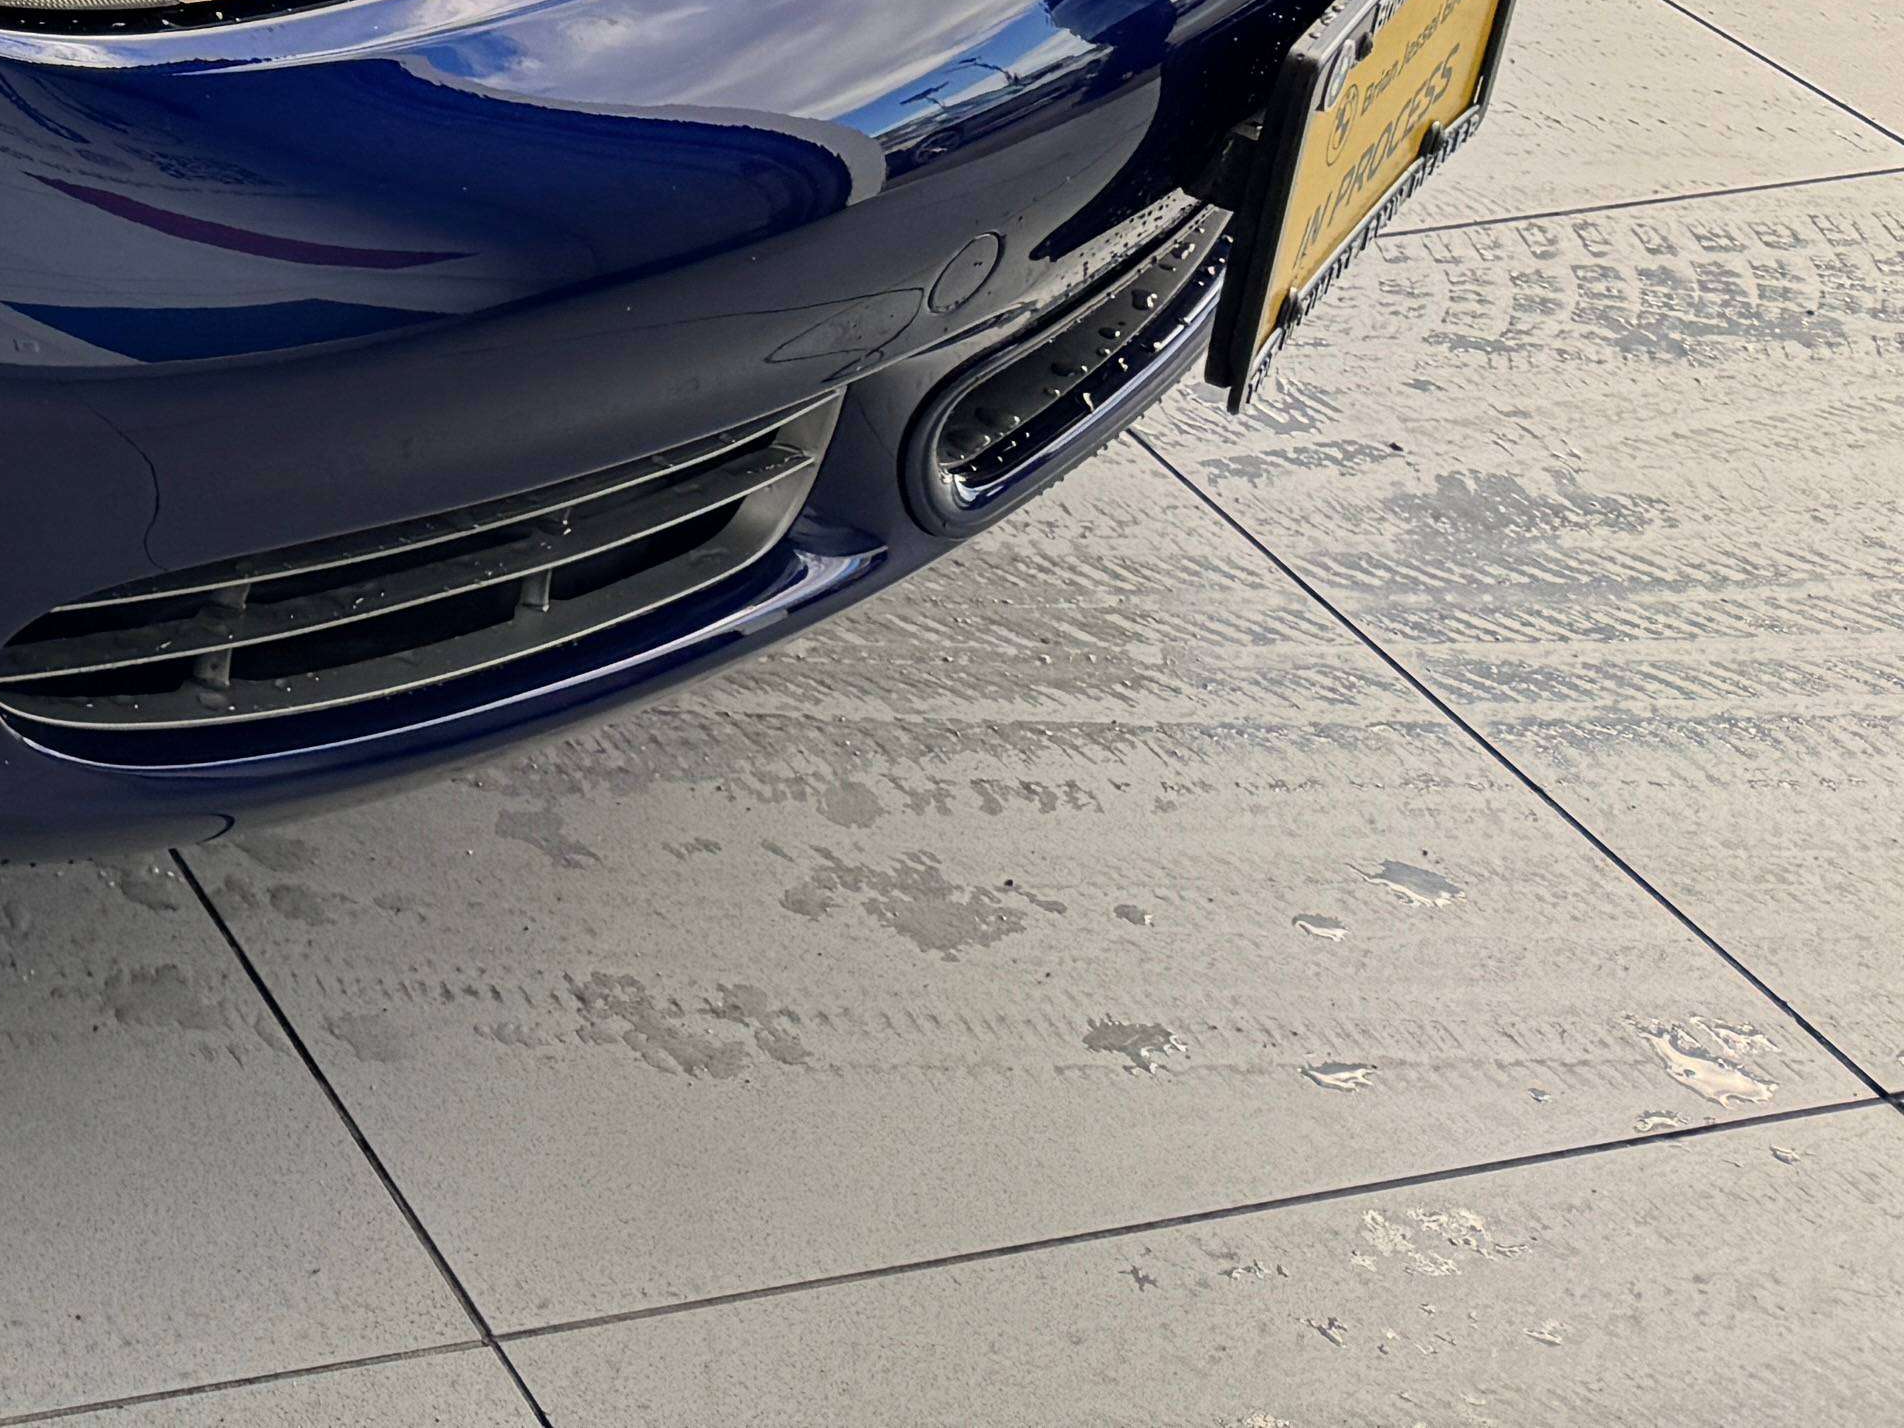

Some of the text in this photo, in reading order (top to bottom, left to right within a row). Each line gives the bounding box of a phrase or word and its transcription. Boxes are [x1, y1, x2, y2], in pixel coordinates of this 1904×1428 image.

[1293, 43, 1460, 269] IN PROCESS
[1362, 60, 1400, 117] Brian
